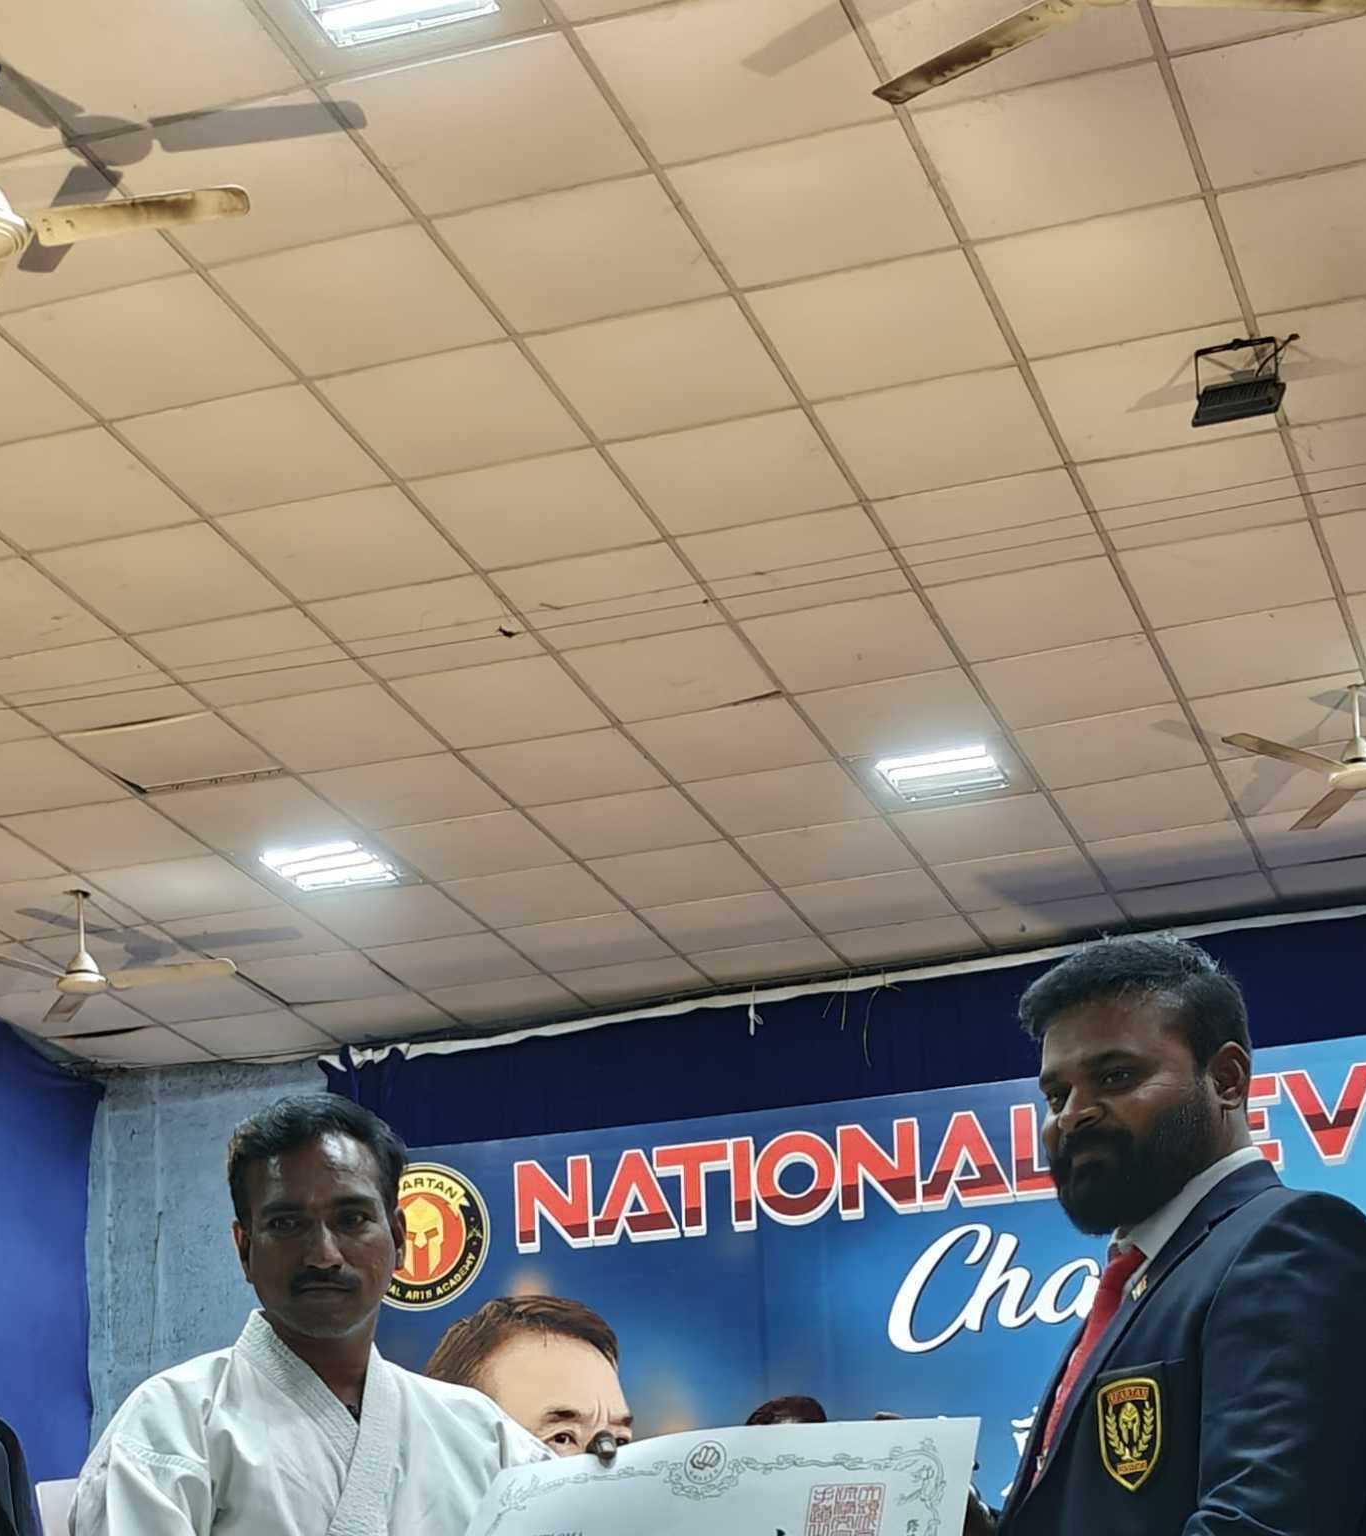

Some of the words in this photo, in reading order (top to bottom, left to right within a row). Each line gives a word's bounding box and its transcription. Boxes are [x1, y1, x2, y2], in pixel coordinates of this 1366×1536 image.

[399, 1177, 459, 1199] ARTAN
[513, 1103, 1059, 1254] NATIONAL
[435, 1252, 477, 1296] ACADEMY
[888, 1223, 1101, 1353] Cha
